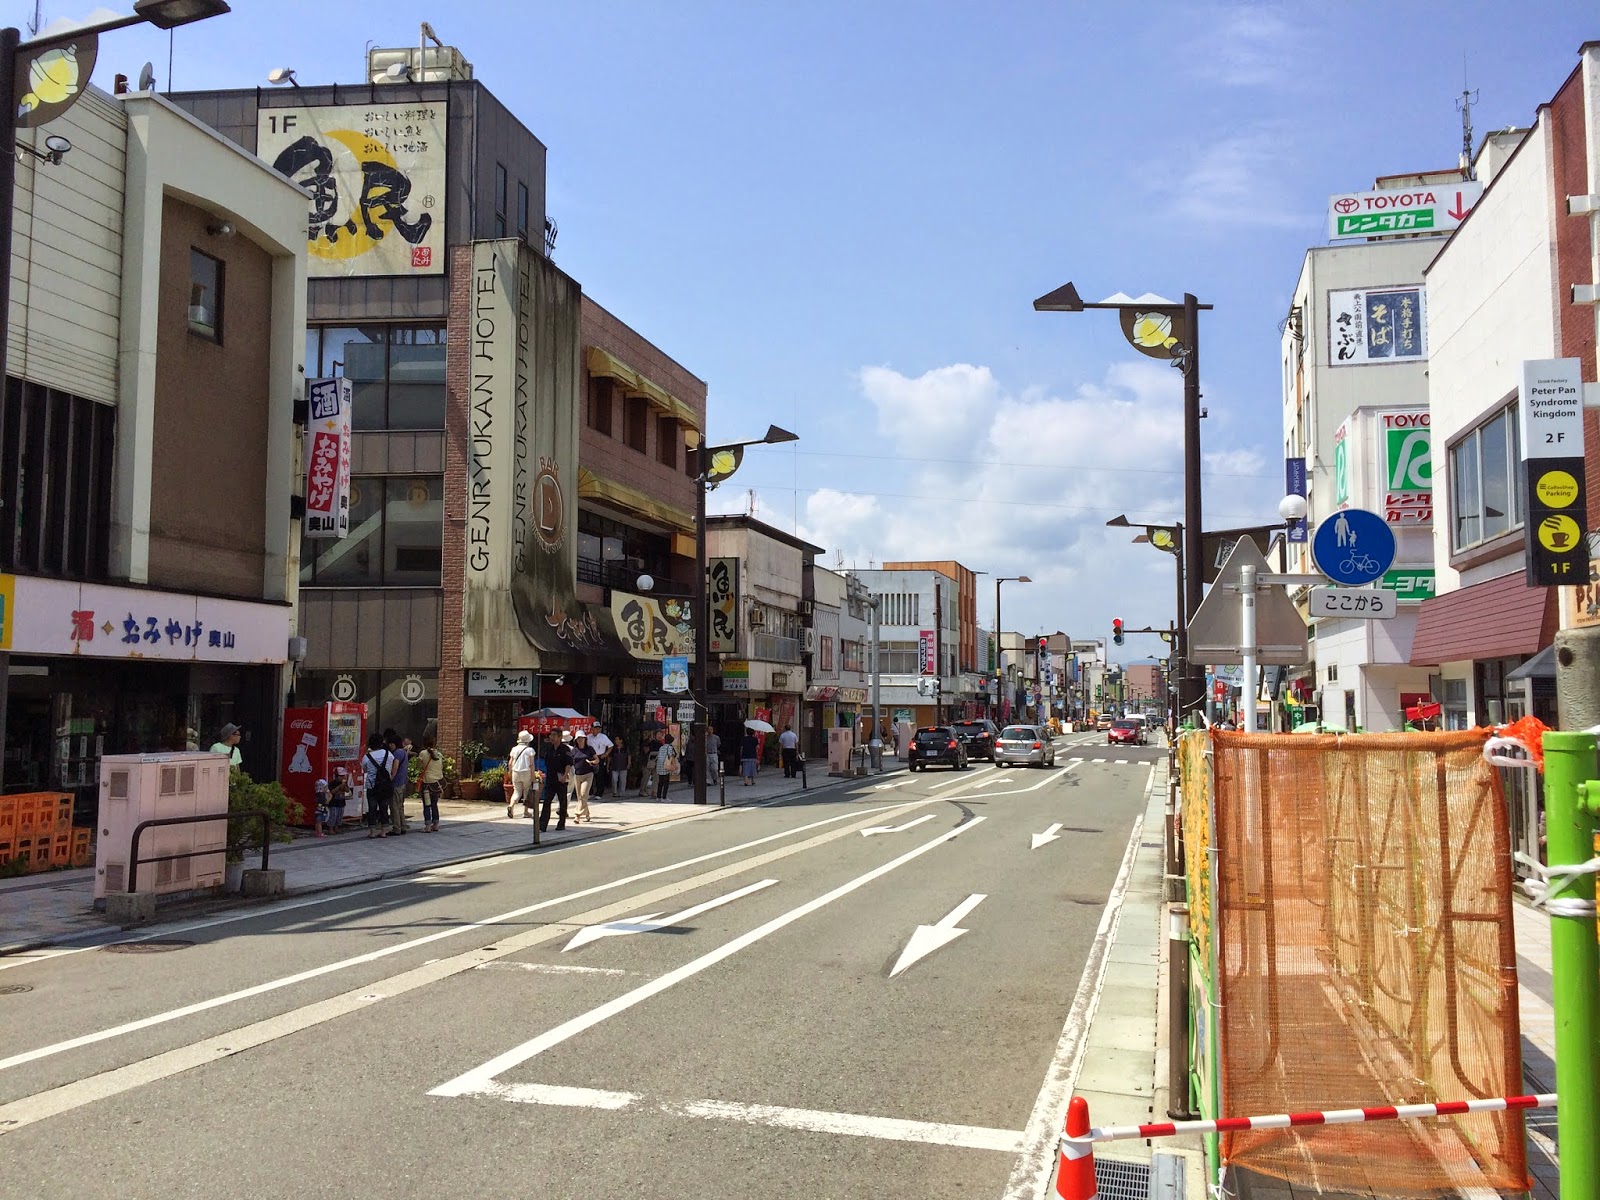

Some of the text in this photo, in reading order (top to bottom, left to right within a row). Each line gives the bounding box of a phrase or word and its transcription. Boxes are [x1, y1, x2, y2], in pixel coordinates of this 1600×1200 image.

[269, 115, 297, 134] 1F
[364, 109, 437, 122] おいしい料理と
[363, 125, 422, 138] おいしい魚と
[363, 141, 428, 154] おいしい地酒
[1364, 192, 1437, 210] TOYOTA
[1343, 213, 1432, 233] レンタカー
[1371, 304, 1392, 347] そば
[1401, 297, 1413, 350] 本格手打ち
[1531, 386, 1576, 395] Peter Pan
[313, 383, 338, 418] 酒
[1530, 398, 1578, 408] Syndrome
[470, 252, 497, 571] GENRYUKAN HOTEL
[515, 261, 530, 574] GENRYUKAN HOTEL
[1533, 410, 1576, 419] Kingdom
[309, 434, 337, 509] おみやげ
[308, 516, 334, 531] 奥山
[712, 561, 734, 641] 魚民
[1325, 595, 1383, 612] ここから
[71, 610, 235, 649] 酒 おみやげ 奥山
[621, 599, 673, 656] 魚民
[338, 682, 353, 698] D
[407, 682, 421, 698] D
